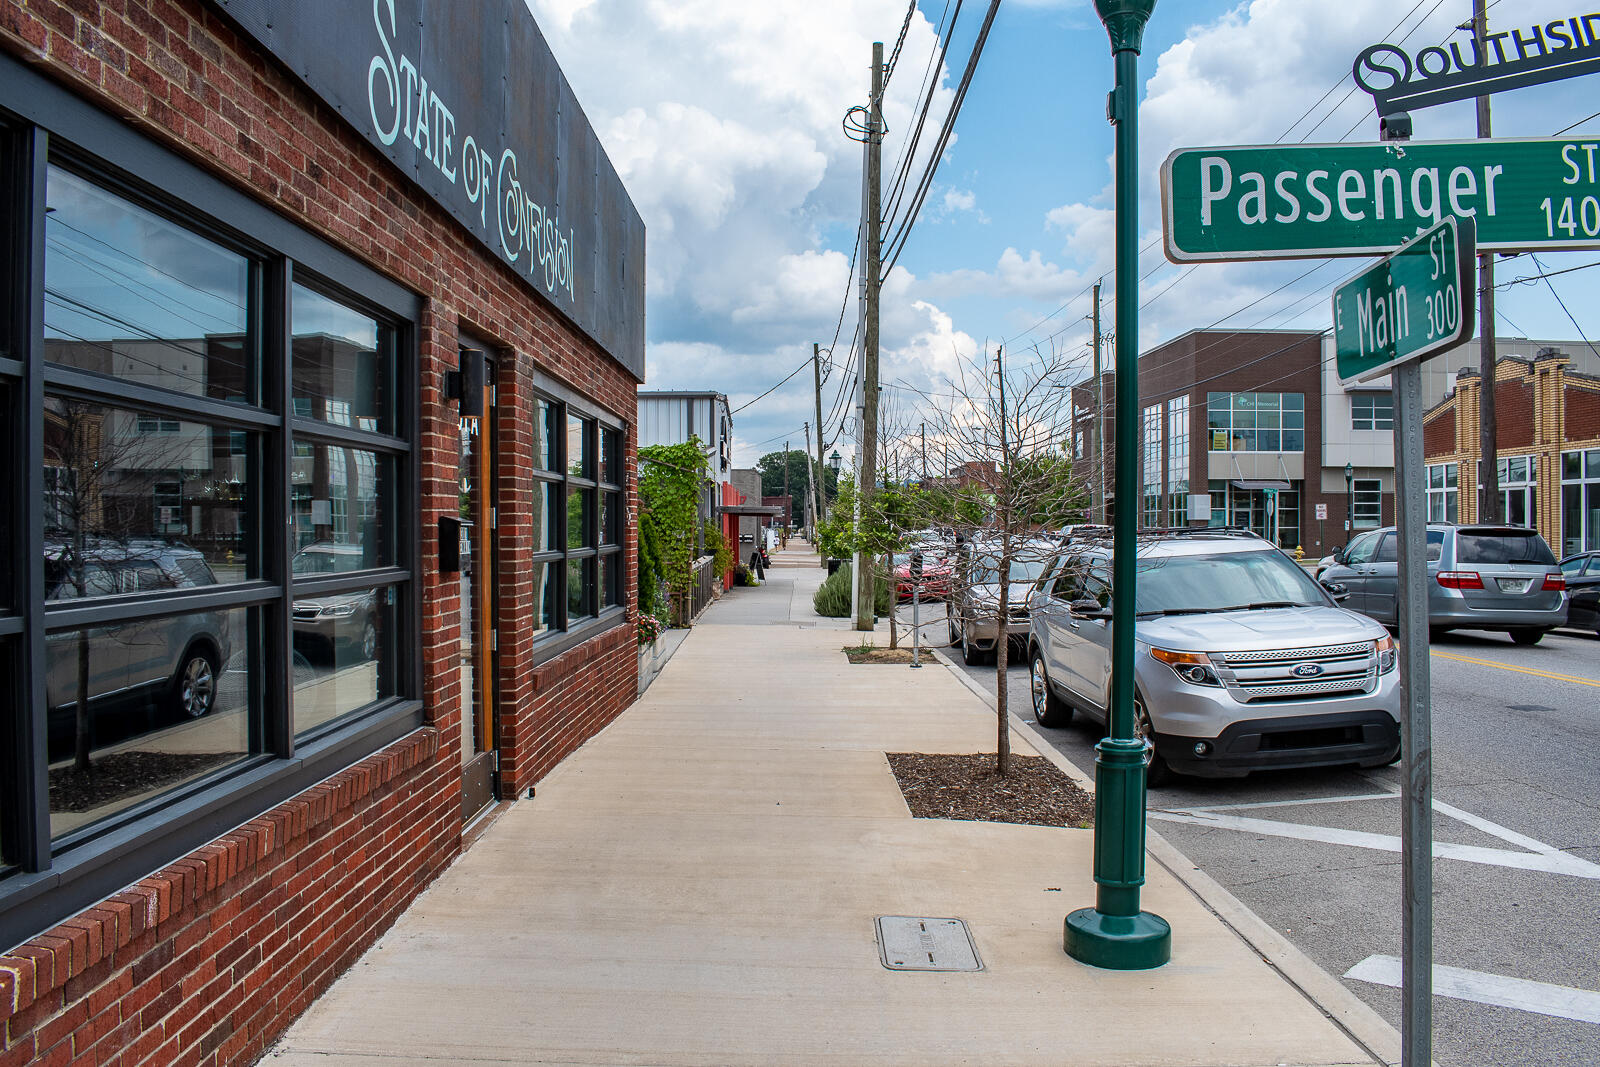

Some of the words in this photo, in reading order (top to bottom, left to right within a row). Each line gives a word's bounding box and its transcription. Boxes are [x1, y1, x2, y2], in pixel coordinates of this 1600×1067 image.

[1200, 156, 1503, 234] Passenger
[1561, 144, 1599, 185] ST
[1336, 294, 1344, 331] E
[1356, 274, 1409, 357] Main
[1429, 229, 1447, 281] ST
[1425, 283, 1456, 340] 300
[1299, 664, 1318, 675] Ford
